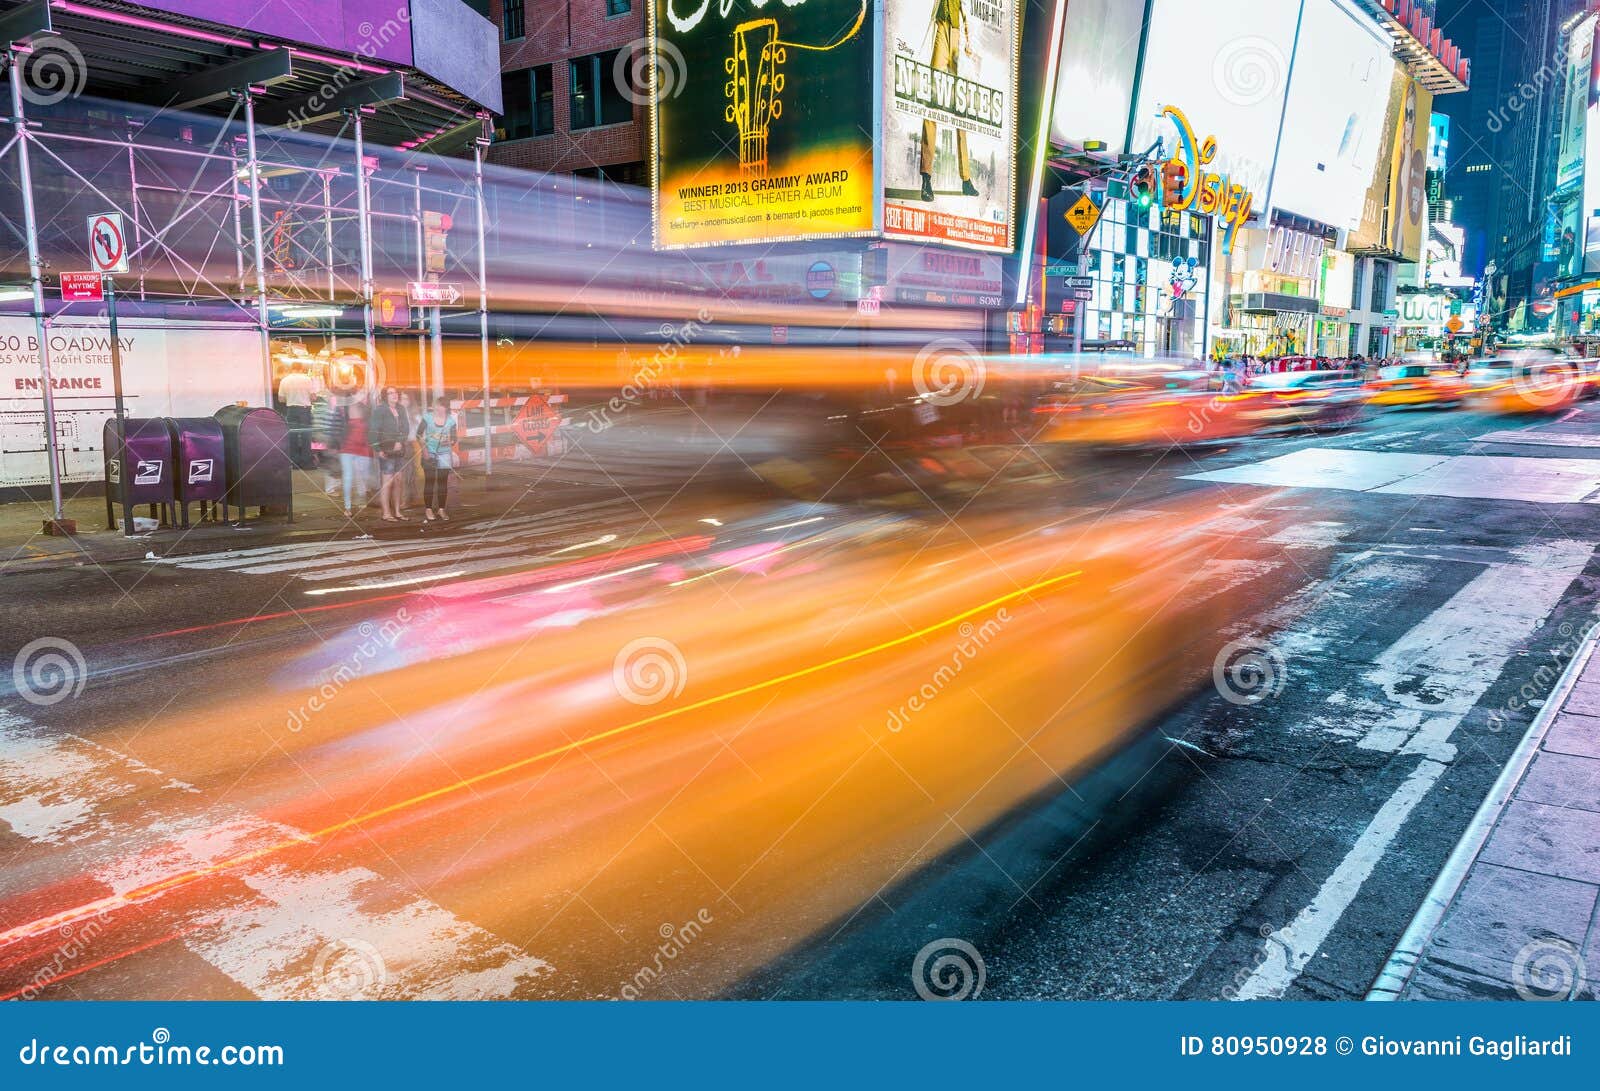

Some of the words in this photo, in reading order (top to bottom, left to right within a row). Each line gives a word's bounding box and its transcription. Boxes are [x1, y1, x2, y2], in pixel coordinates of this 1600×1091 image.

[896, 57, 1003, 125] NEWSIES
[679, 187, 722, 199] WINNER!
[725, 182, 748, 194] 2013
[751, 176, 800, 191] GRAMMY
[806, 170, 848, 185] AWARD
[684, 200, 707, 212] BEST
[710, 195, 752, 209] MUSICAL
[756, 190, 801, 204] THEATER
[804, 186, 842, 199] ALBUM
[773, 209, 801, 221] bernard
[835, 204, 862, 215] theatre
[886, 207, 902, 229] SEIZE
[903, 208, 914, 231] THE
[914, 211, 926, 232] DAY
[68, 282, 97, 290] ANYTIME
[859, 301, 880, 313] ATM
[979, 296, 1003, 306] SONY
[28, 336, 135, 352] BOADWAY
[16, 355, 43, 364] WES
[85, 355, 114, 364] STREE
